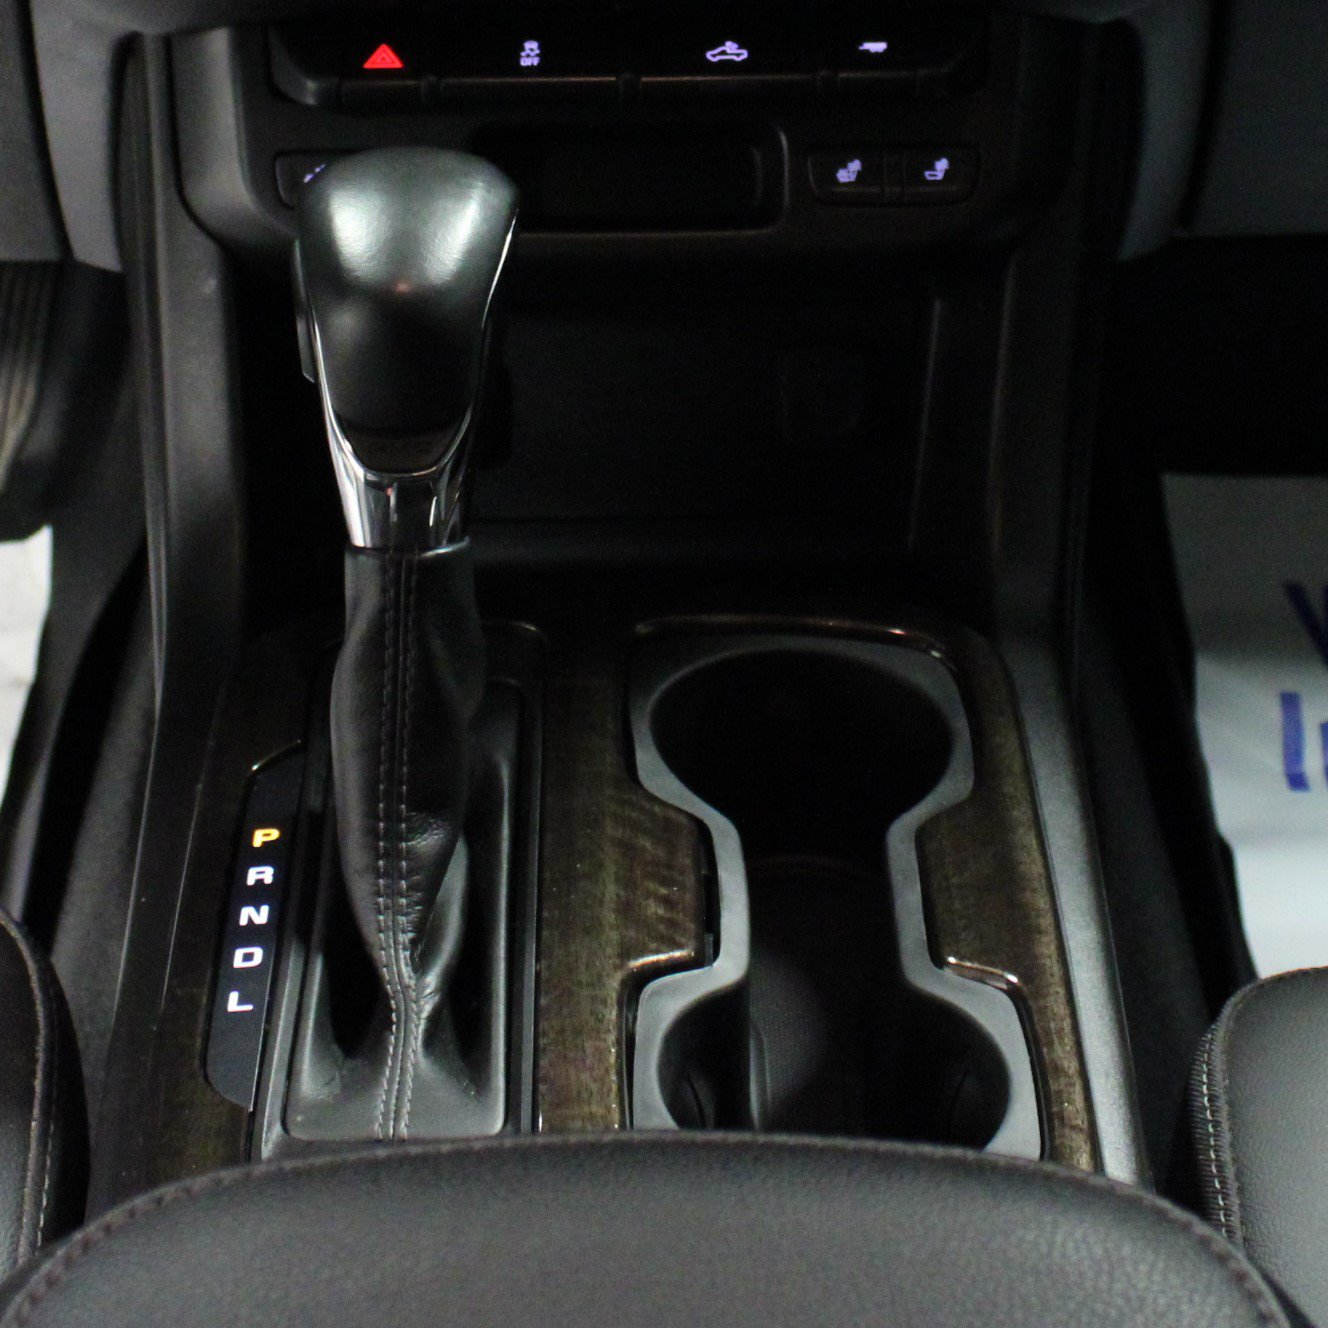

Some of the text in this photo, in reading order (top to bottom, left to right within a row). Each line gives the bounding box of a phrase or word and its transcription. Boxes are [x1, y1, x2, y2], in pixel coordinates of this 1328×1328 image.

[252, 828, 281, 848] P
[246, 866, 275, 886] R
[239, 904, 270, 926] N
[233, 946, 264, 969] D
[227, 991, 254, 1013] L
